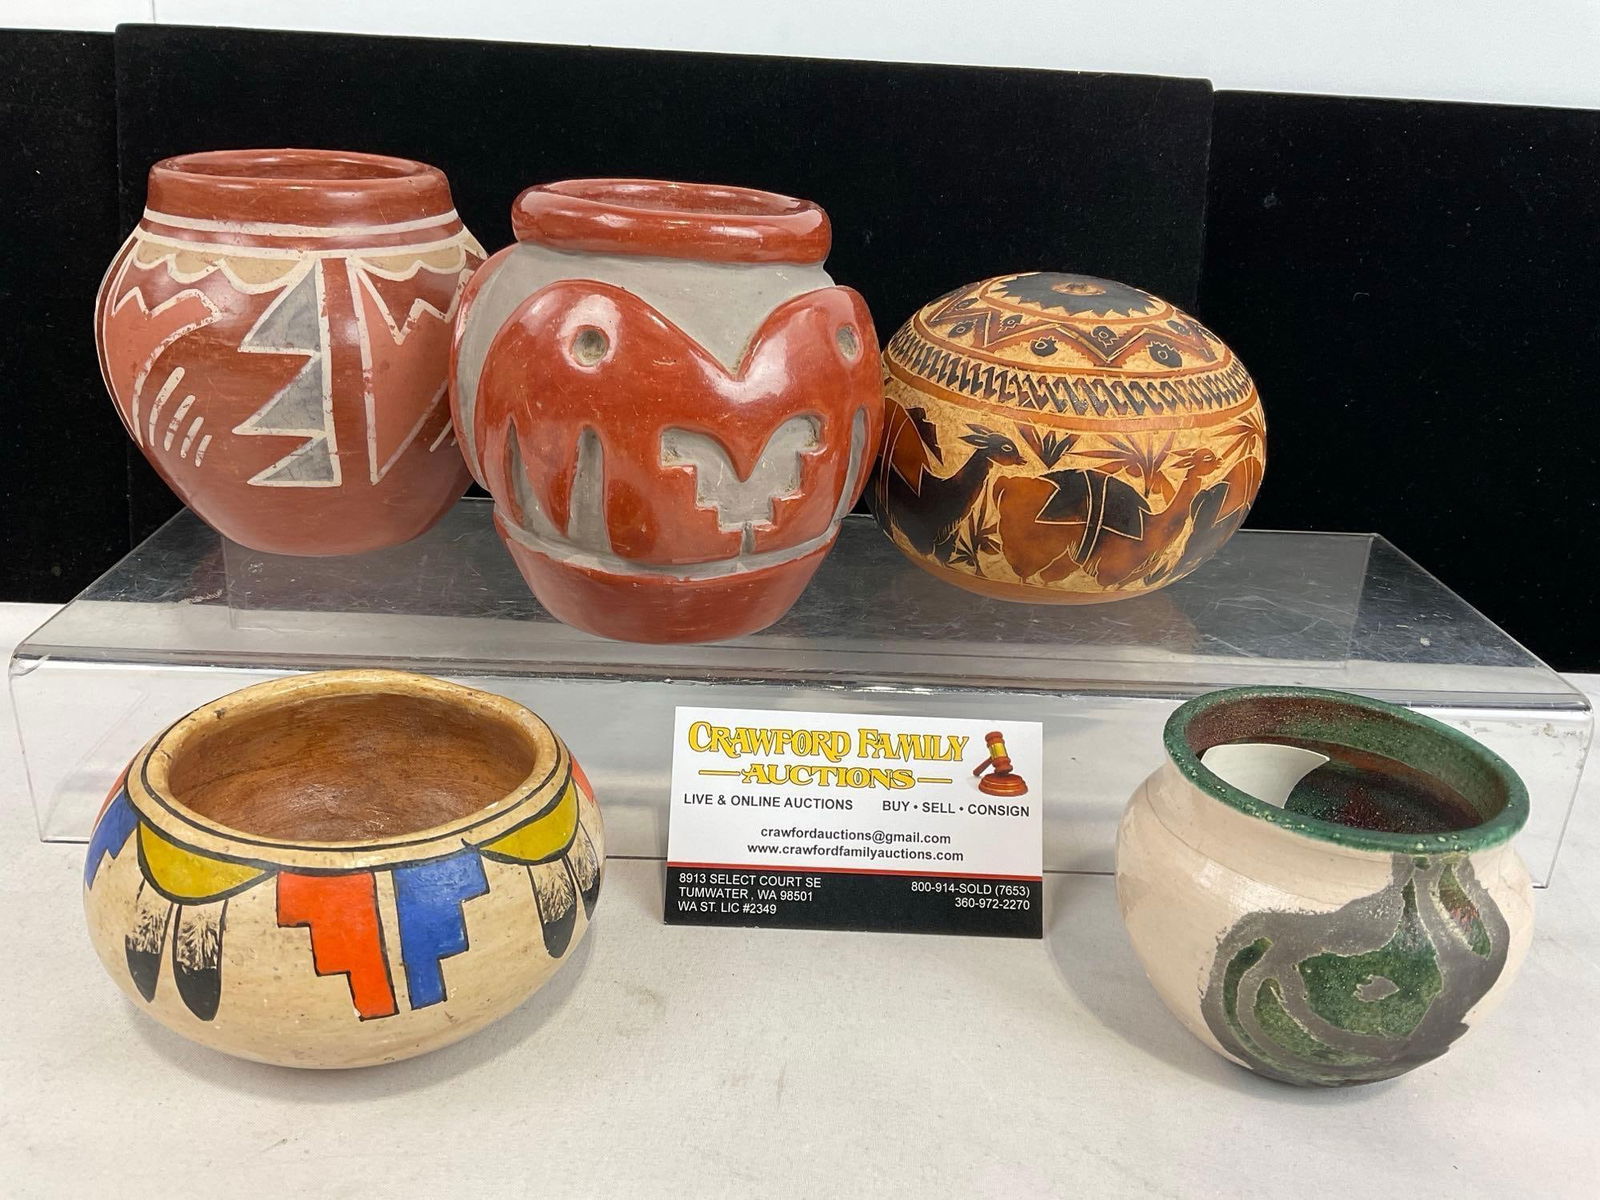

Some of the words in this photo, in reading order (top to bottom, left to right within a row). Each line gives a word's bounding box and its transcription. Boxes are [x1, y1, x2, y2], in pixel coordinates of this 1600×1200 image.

[688, 720, 851, 763] CRAWFORD
[857, 728, 970, 762] FAMILY
[741, 763, 916, 791] AUCTIONS
[684, 793, 713, 805] LIVE
[717, 794, 727, 806] &
[730, 795, 781, 808] ONLINE
[783, 797, 853, 810] AUCTIONS
[882, 800, 910, 812] BUY
[922, 802, 956, 814] SELL
[967, 804, 1030, 817] CONSIGN
[760, 827, 951, 845] crawfordauctions@gmail.com
[747, 843, 964, 861] www.crawfordfamilyauctions.com
[679, 873, 707, 884] 8913
[709, 874, 756, 886] SELECT
[759, 875, 802, 887] COURT
[805, 876, 822, 888] SE
[911, 881, 992, 895] 800-914-SOLD
[995, 883, 1031, 897] (7653)
[757, 889, 777, 900] WA
[780, 890, 813, 902] 98501
[954, 897, 1031, 911] 360-972-2270
[677, 900, 698, 912] WA
[699, 901, 717, 913] ST.
[720, 902, 740, 913] LIC
[742, 903, 777, 915] #2349
